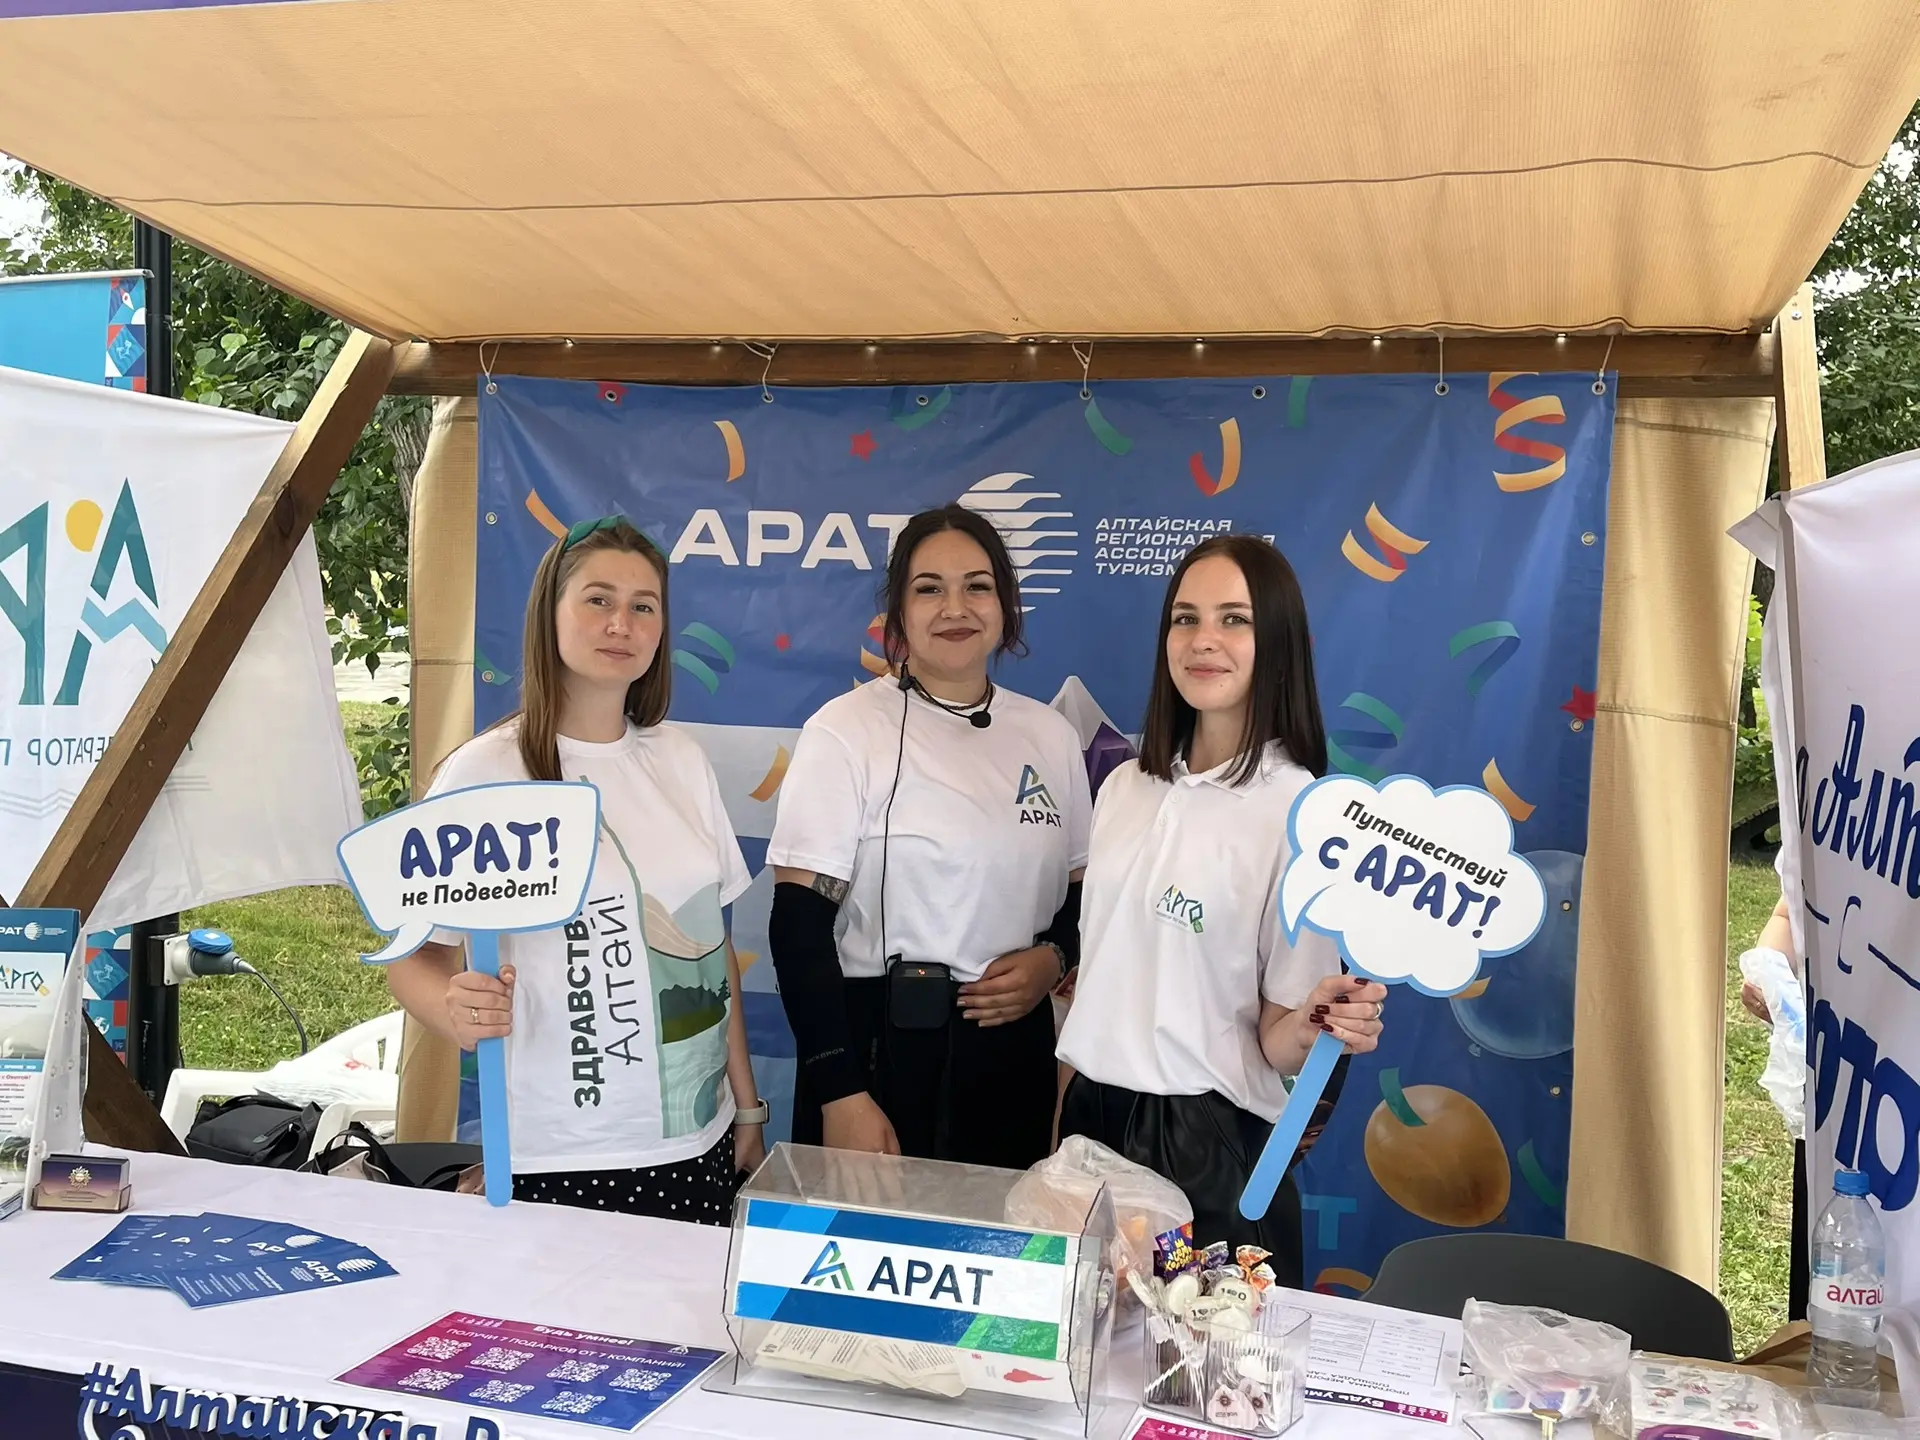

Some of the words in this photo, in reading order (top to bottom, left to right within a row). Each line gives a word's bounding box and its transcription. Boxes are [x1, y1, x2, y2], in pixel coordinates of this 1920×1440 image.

[1096, 516, 1232, 531] АЛТАЙСКАЯ
[1095, 547, 1186, 562] АССОЦИ
[1096, 562, 1176, 576] ТУРИЗМ
[1020, 809, 1061, 828] АРАТ
[400, 817, 561, 879] АРАТ!
[1343, 800, 1508, 888] Путешествуй
[402, 891, 428, 907] не
[434, 876, 557, 904] Подведет!
[1354, 844, 1501, 938] АРАТ!
[564, 911, 605, 1108] ЗДРАВСТВ
[301, 1261, 342, 1282] АРАТ
[867, 1256, 993, 1305] АРАТ
[446, 1328, 498, 1341] ПОЛУЧИ
[509, 1338, 577, 1354] ПОДАРКОВ
[607, 1354, 686, 1368] КОМПАНИЙ!
[1348, 1380, 1410, 1395] ПРОГРАММА
